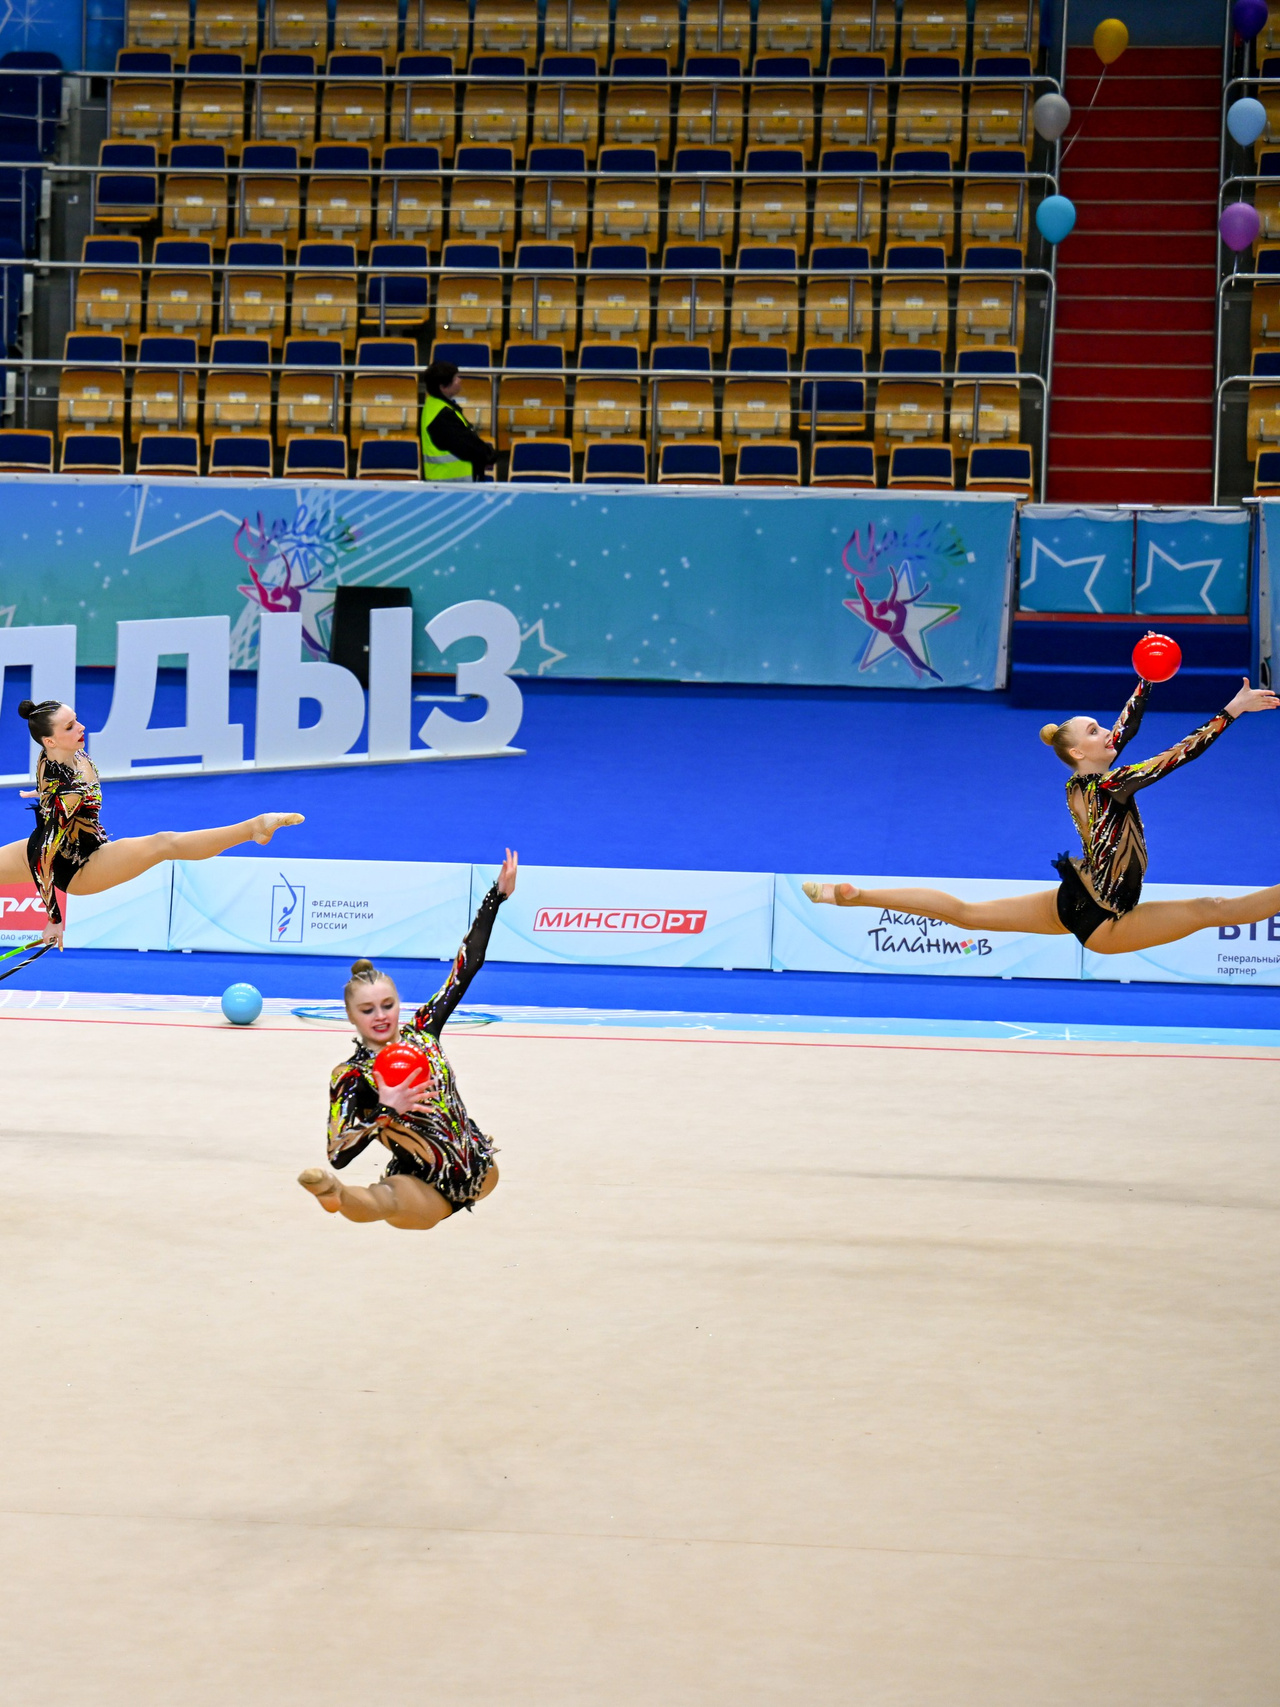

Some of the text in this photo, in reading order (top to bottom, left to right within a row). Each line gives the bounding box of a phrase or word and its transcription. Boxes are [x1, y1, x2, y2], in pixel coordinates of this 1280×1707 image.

[311, 900, 369, 908] ФЕДЕРАЦИЯ
[311, 911, 374, 919] ГИМНАСТИКИ
[539, 911, 704, 931] МИНСПОРТ
[310, 922, 348, 930] РОССИИ
[1217, 967, 1257, 977] партнер
